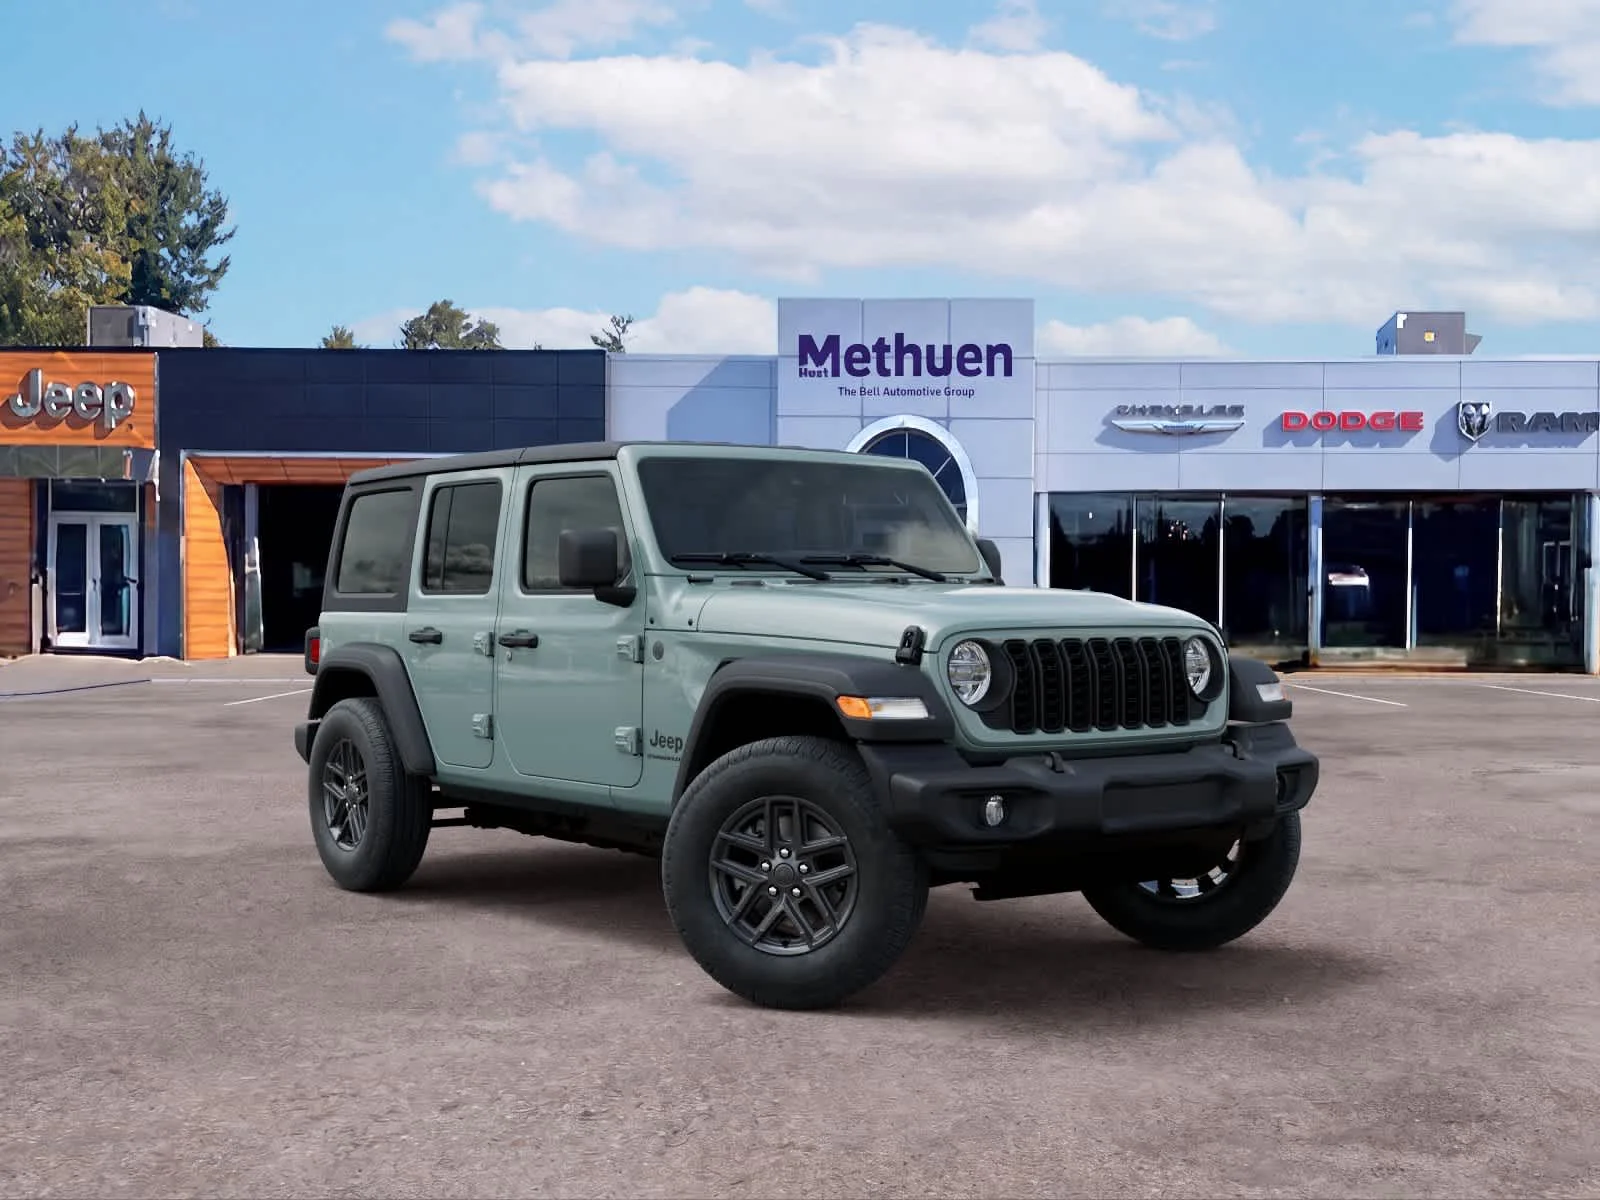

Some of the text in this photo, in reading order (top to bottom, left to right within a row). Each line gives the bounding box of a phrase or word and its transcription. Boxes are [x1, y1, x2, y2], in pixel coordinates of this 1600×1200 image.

[798, 332, 1013, 377] Methuen
[9, 368, 136, 429] Jeep
[838, 386, 975, 399] The Bell Automotive Group
[1282, 411, 1424, 432] DODGE
[1497, 411, 1600, 433] RAM
[650, 729, 683, 753] Jeep
